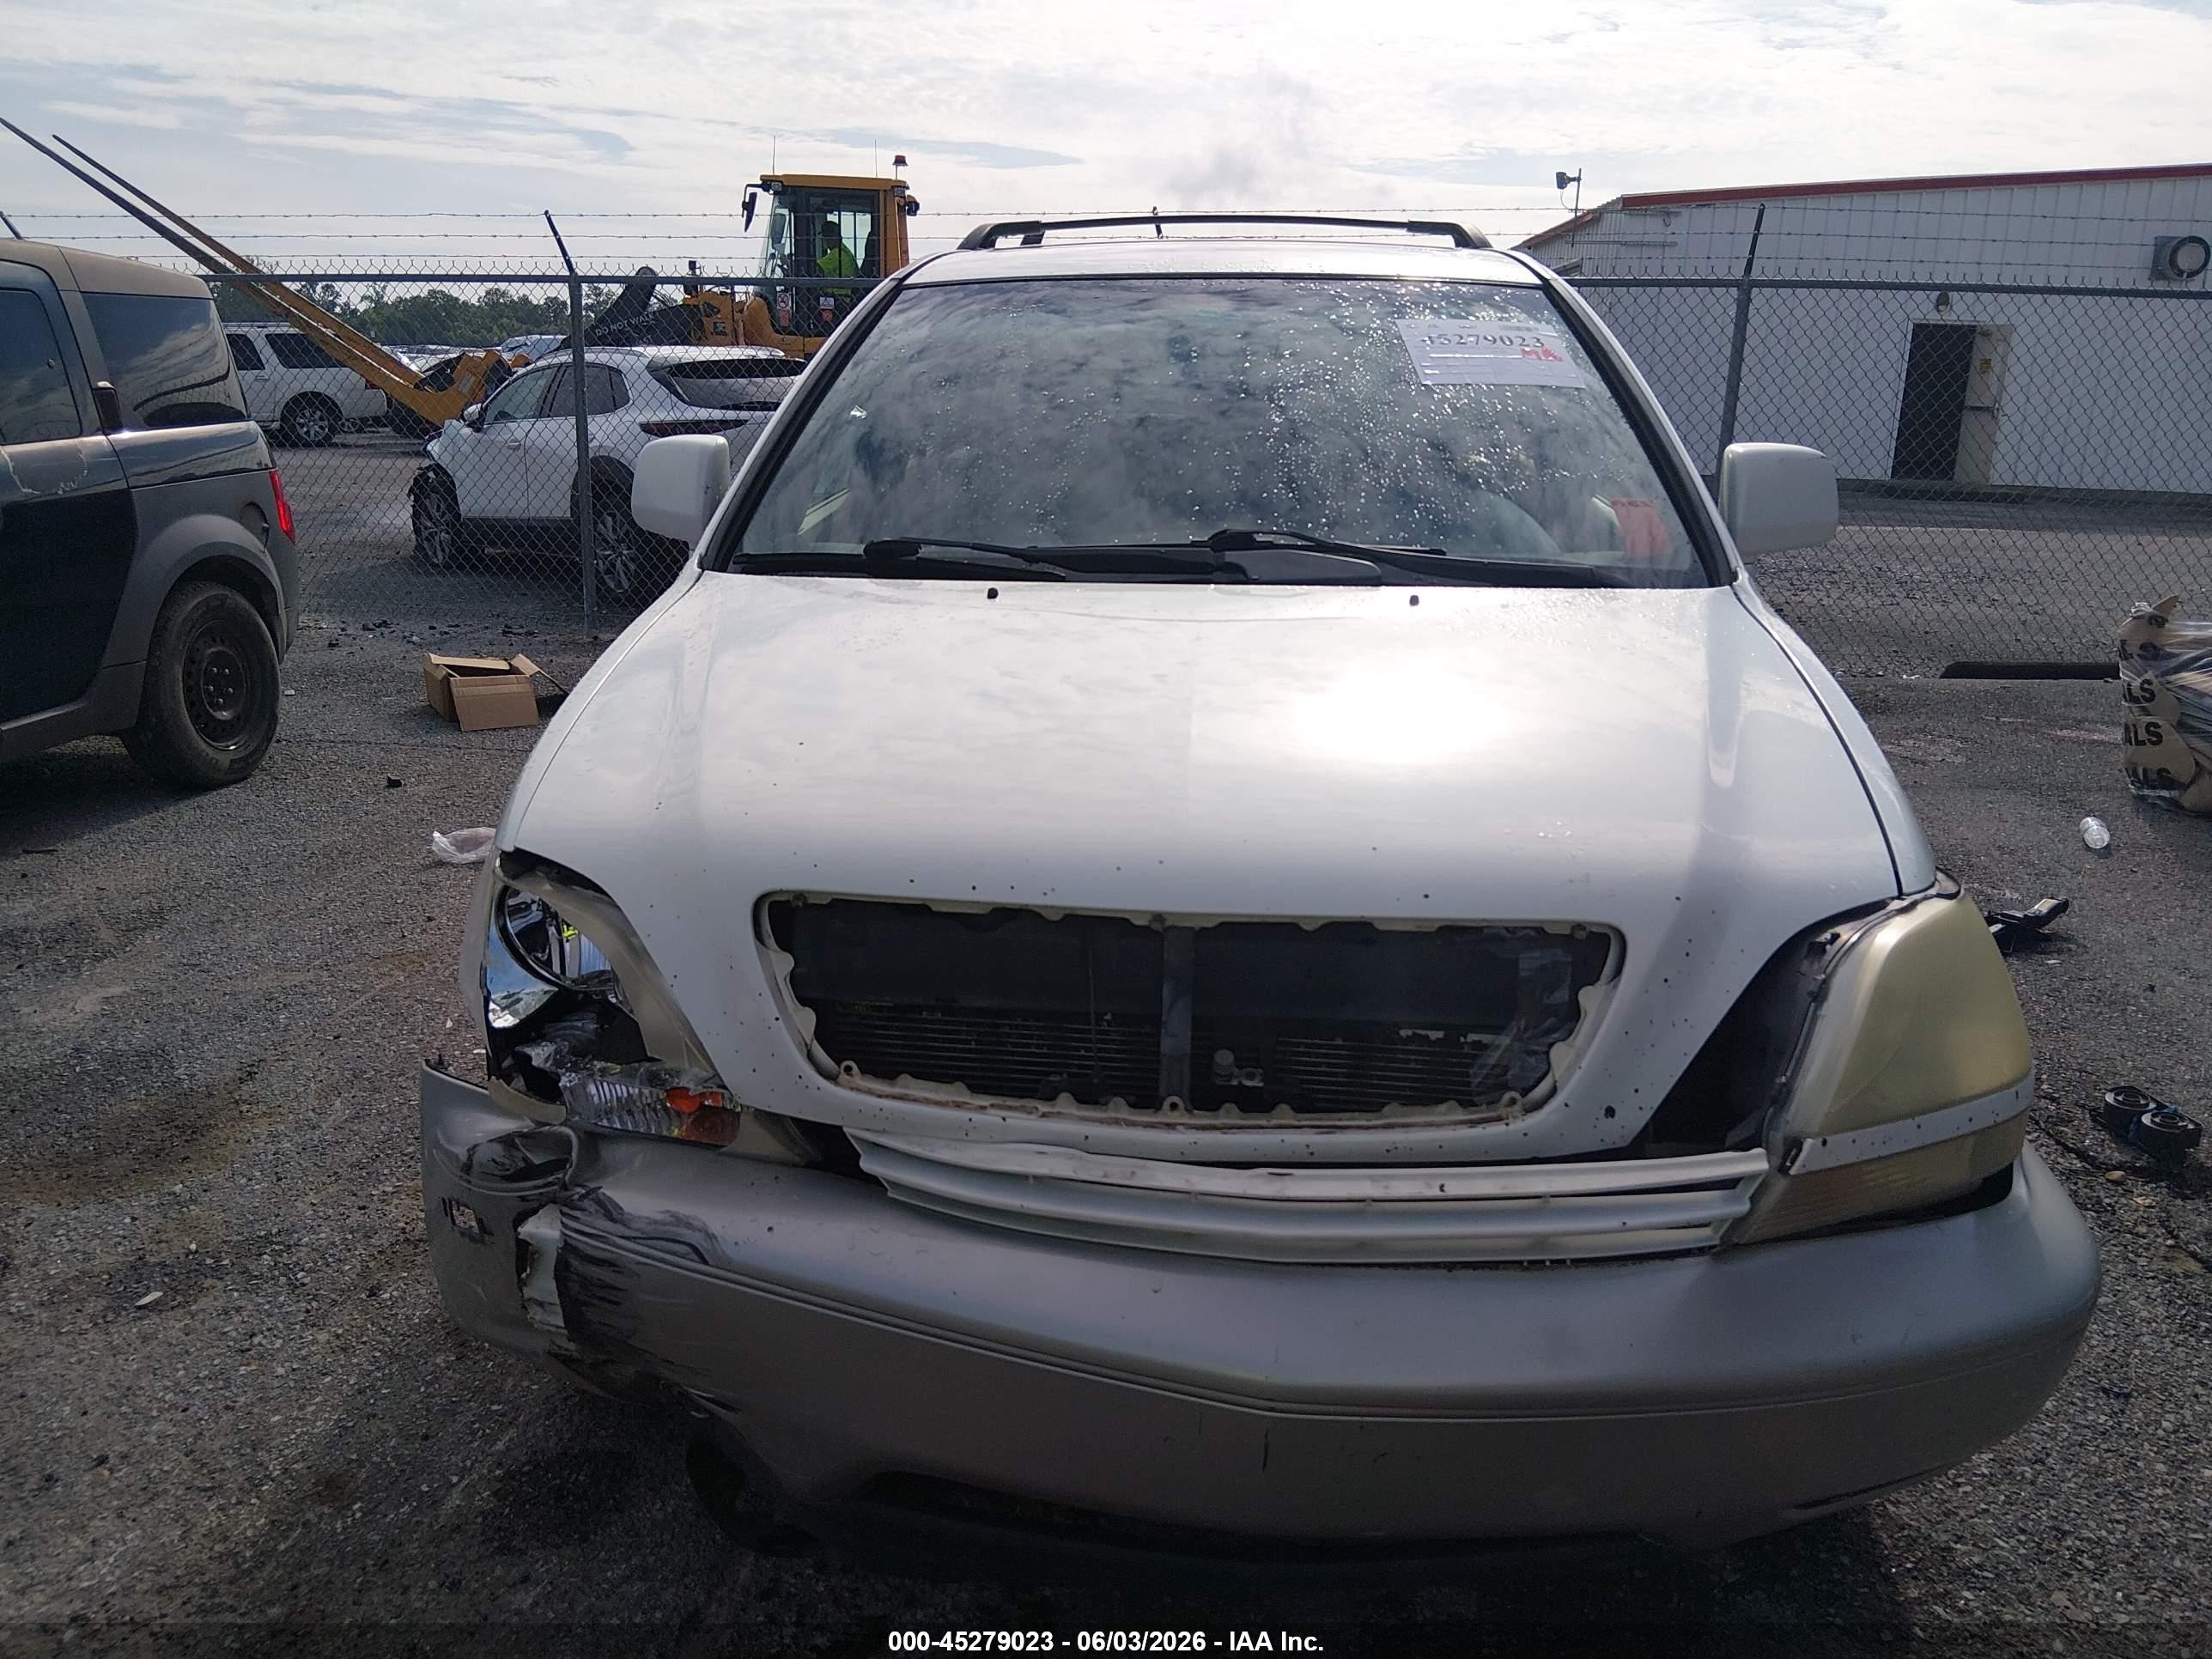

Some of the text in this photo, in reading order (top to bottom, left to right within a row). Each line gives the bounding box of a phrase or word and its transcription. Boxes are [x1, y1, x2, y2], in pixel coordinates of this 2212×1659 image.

[595, 311, 655, 337] DO NOT WALK
